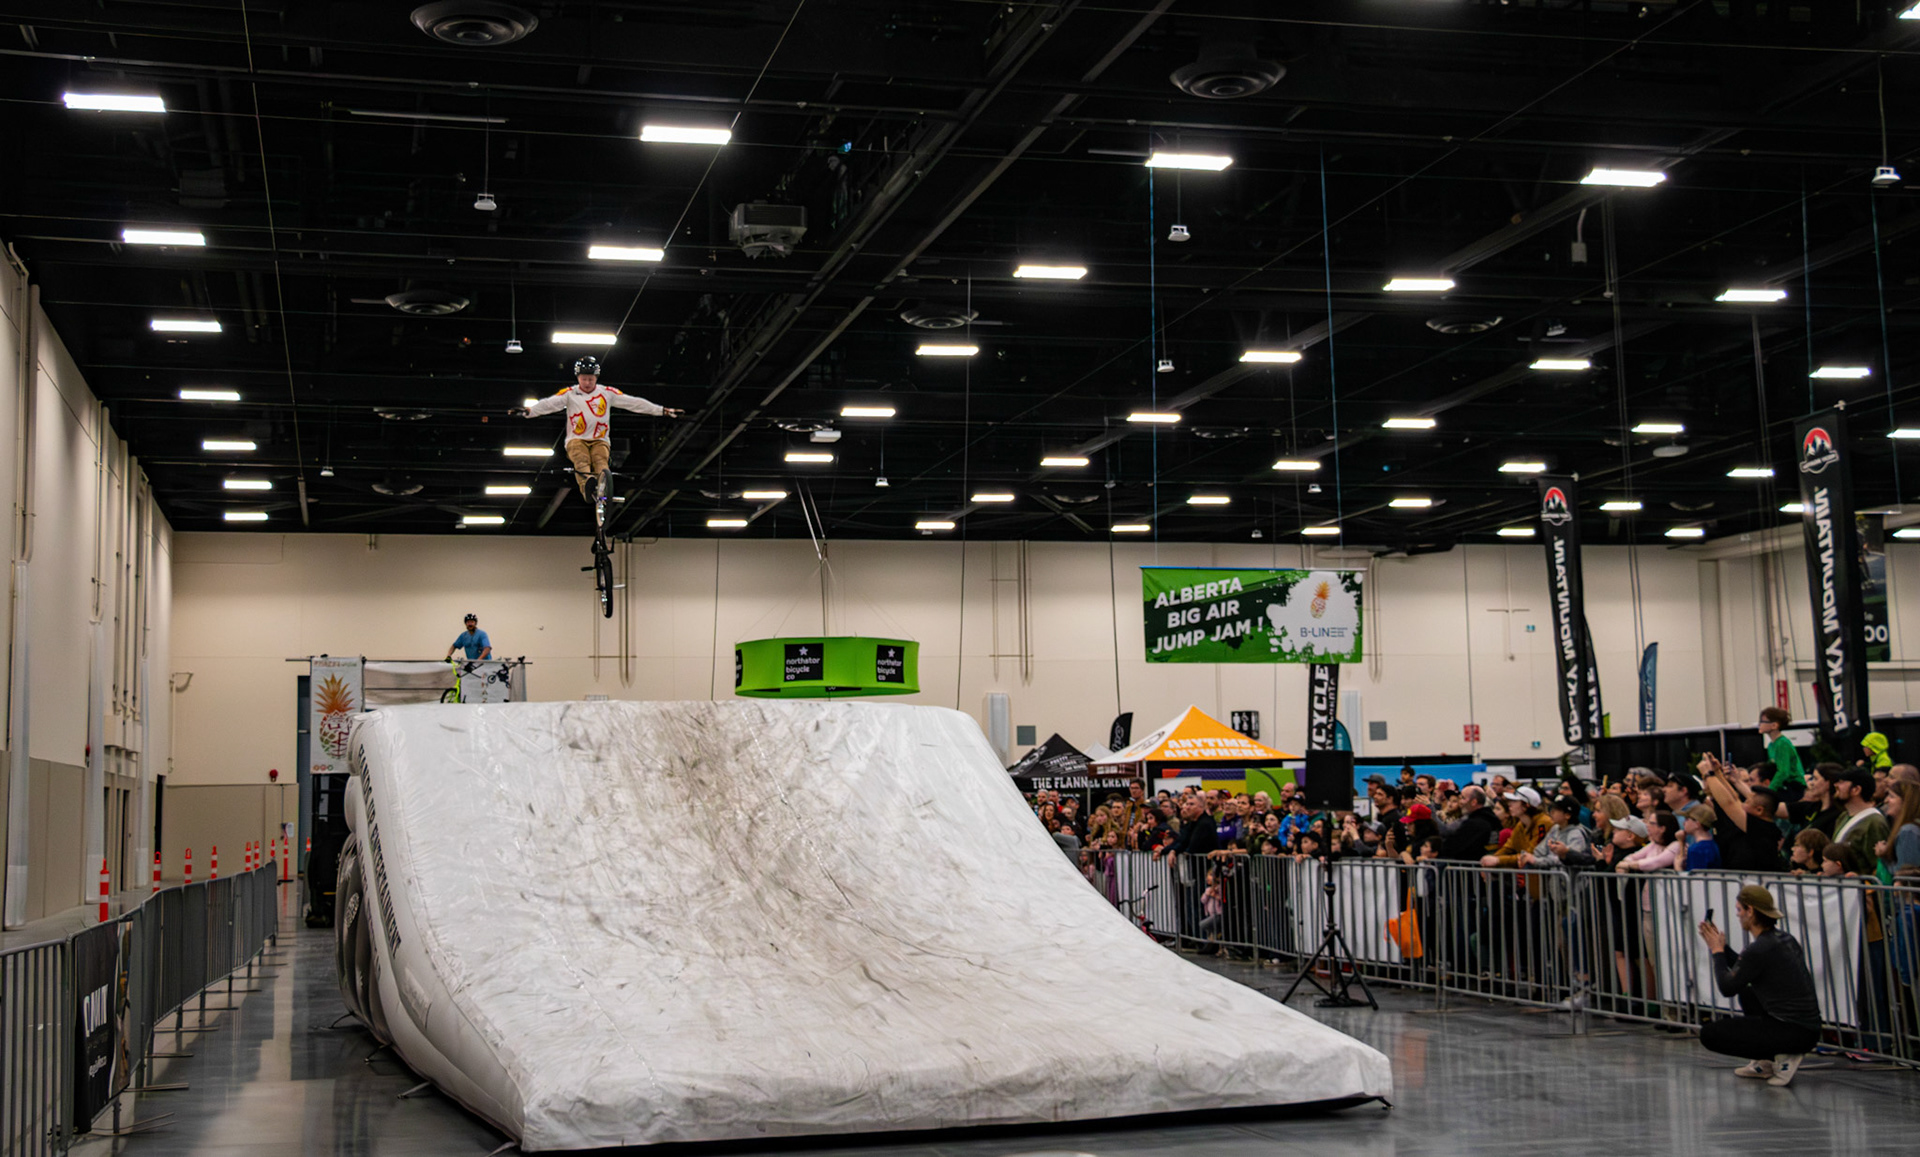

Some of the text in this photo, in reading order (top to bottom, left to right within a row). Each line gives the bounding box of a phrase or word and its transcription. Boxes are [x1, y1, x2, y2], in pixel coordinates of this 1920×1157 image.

[1154, 577, 1243, 609] ALBERTA
[1167, 600, 1240, 628] BIG AIR
[1152, 629, 1206, 654] JUMP
[1210, 619, 1250, 643] JAM
[786, 657, 820, 665] northstar
[786, 665, 810, 674] bicycle
[1312, 664, 1329, 744] CYCLE
[1031, 777, 1052, 789] THE
[1102, 778, 1131, 788] CREW
[358, 743, 372, 798] HANDS
[366, 798, 376, 825] UP
[371, 823, 402, 960] ENTERTAINMENT
